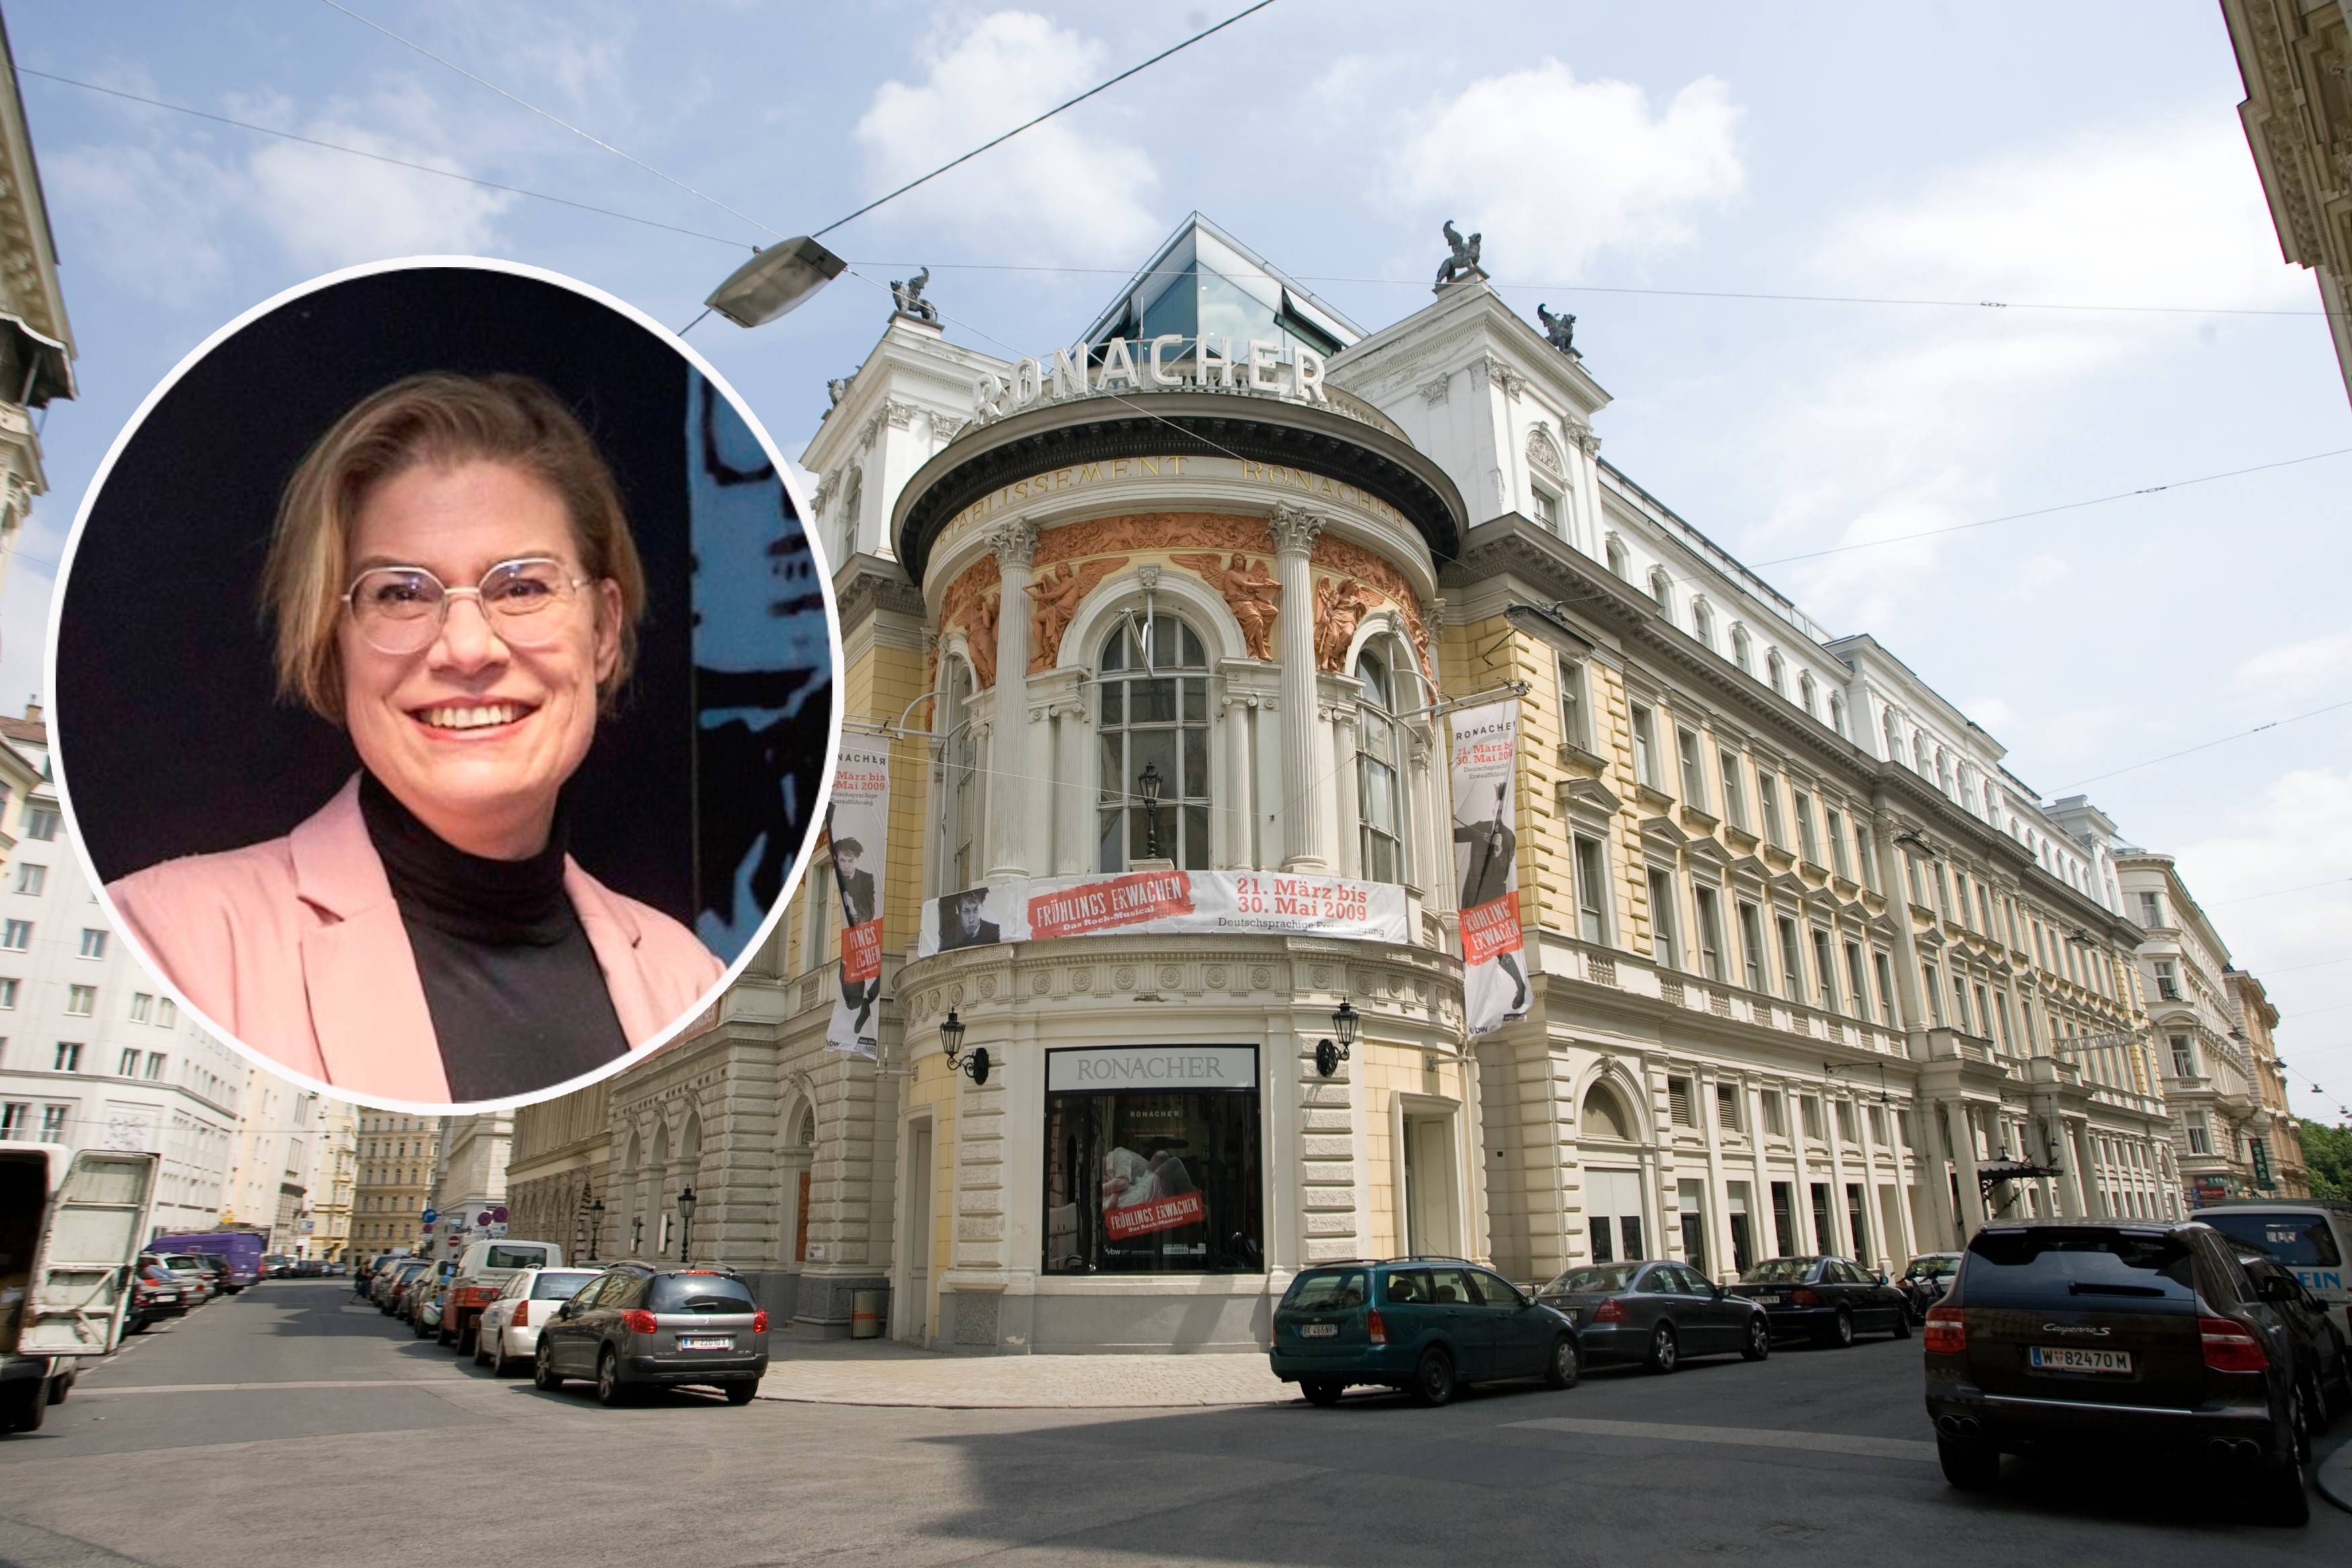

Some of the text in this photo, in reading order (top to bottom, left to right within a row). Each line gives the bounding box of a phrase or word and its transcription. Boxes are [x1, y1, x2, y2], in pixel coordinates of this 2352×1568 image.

[973, 334, 1328, 426] RONACHER
[1242, 460, 1405, 528] RONACHER
[837, 753, 885, 765] NACHER
[1456, 756, 1471, 765] 30.
[1473, 754, 1496, 763] Mai
[836, 771, 886, 781] März bis
[836, 781, 885, 791] Mai 2009
[1236, 877, 1367, 903] 21. März bis
[1036, 877, 1182, 928] FRÜHLINGS ERWACHEN
[1237, 897, 1367, 922] 30. Mai 2009
[1063, 905, 1155, 930] Das Rock-Musical
[1218, 917, 1314, 931] Deutschsprachige
[1463, 900, 1511, 932] FRÜHLING
[1077, 1057, 1225, 1081] RONACHER
[1111, 1197, 1198, 1230] FRÜHLINGS ERWACHEN
[2043, 1323, 2097, 1335] Cayenne
[2043, 1350, 2053, 1364] W
[2065, 1351, 2113, 1368] 82470
[2116, 1354, 2127, 1369] M
